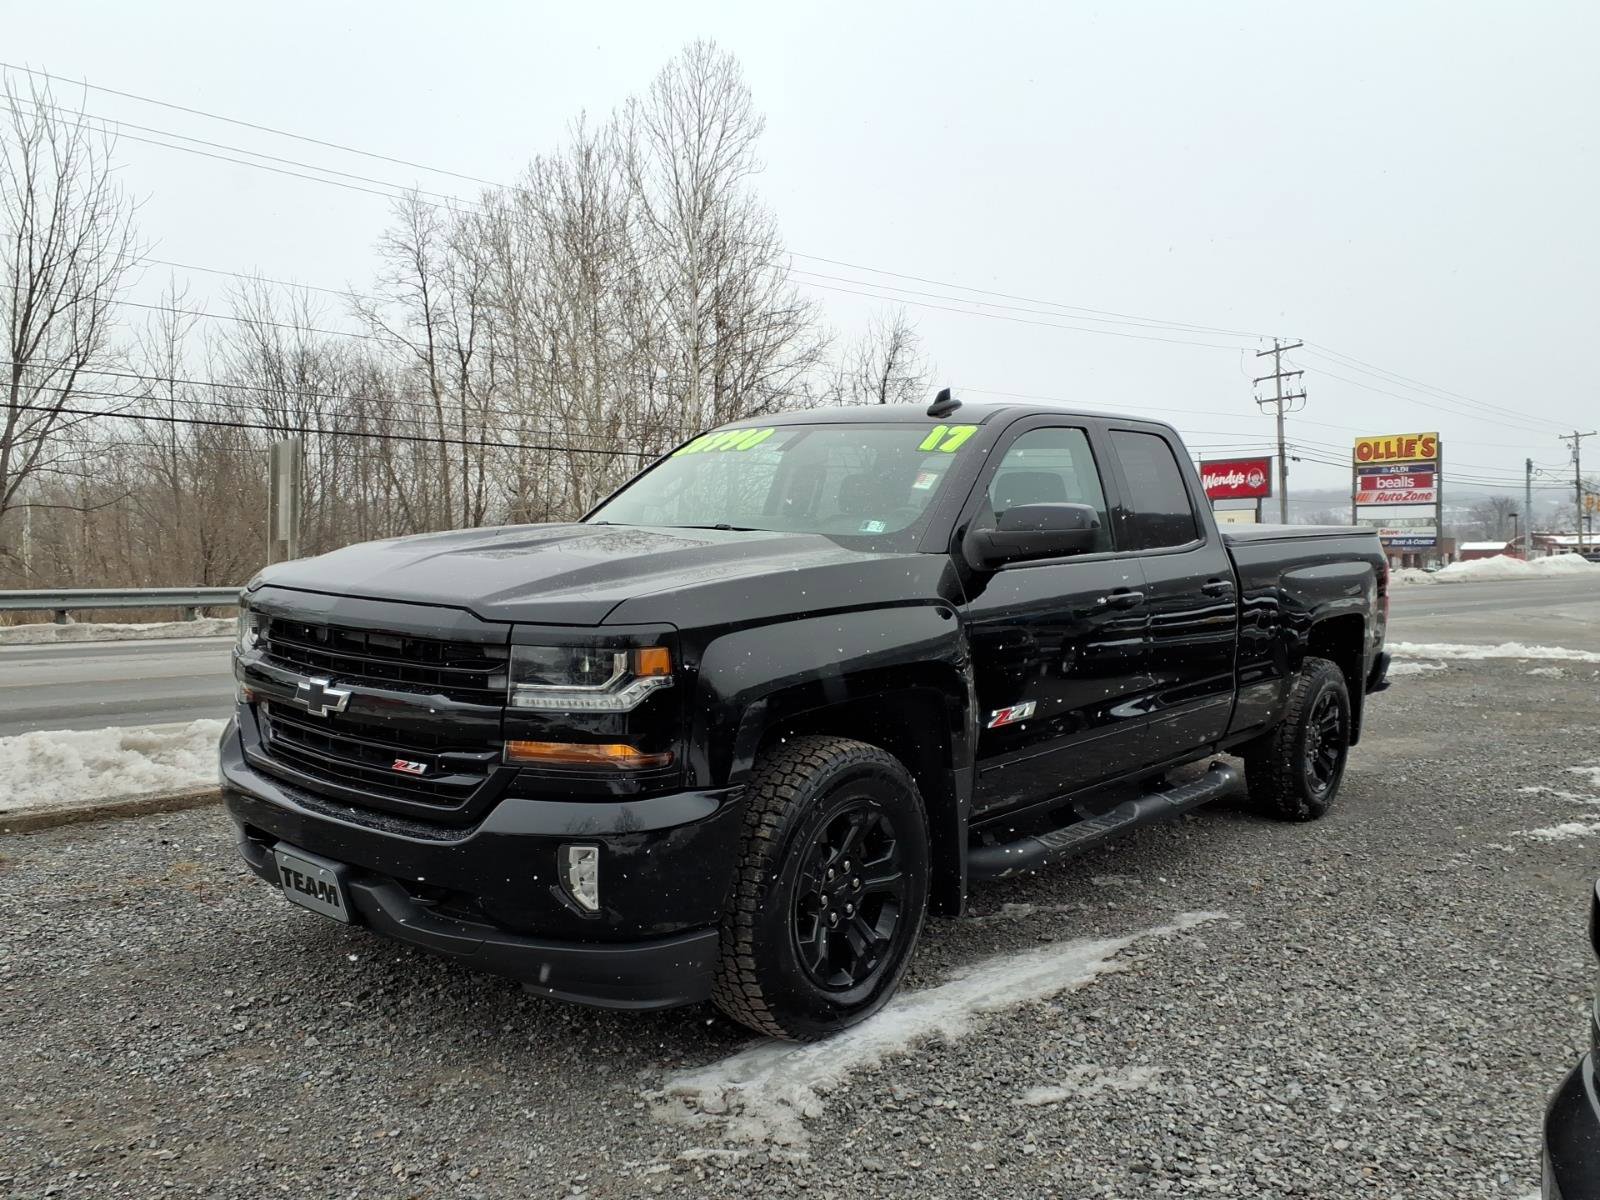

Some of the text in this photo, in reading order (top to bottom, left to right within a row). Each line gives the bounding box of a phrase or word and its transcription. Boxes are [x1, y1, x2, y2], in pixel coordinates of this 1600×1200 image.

[917, 425, 978, 453] 17
[1356, 435, 1436, 461] OLLIE'S
[1202, 469, 1245, 490] Wendy's
[1376, 476, 1415, 489] bealls
[1375, 491, 1433, 502] AutoZone
[987, 701, 1037, 729] Z71
[391, 758, 428, 775] Z71
[280, 866, 340, 907] TEAM
